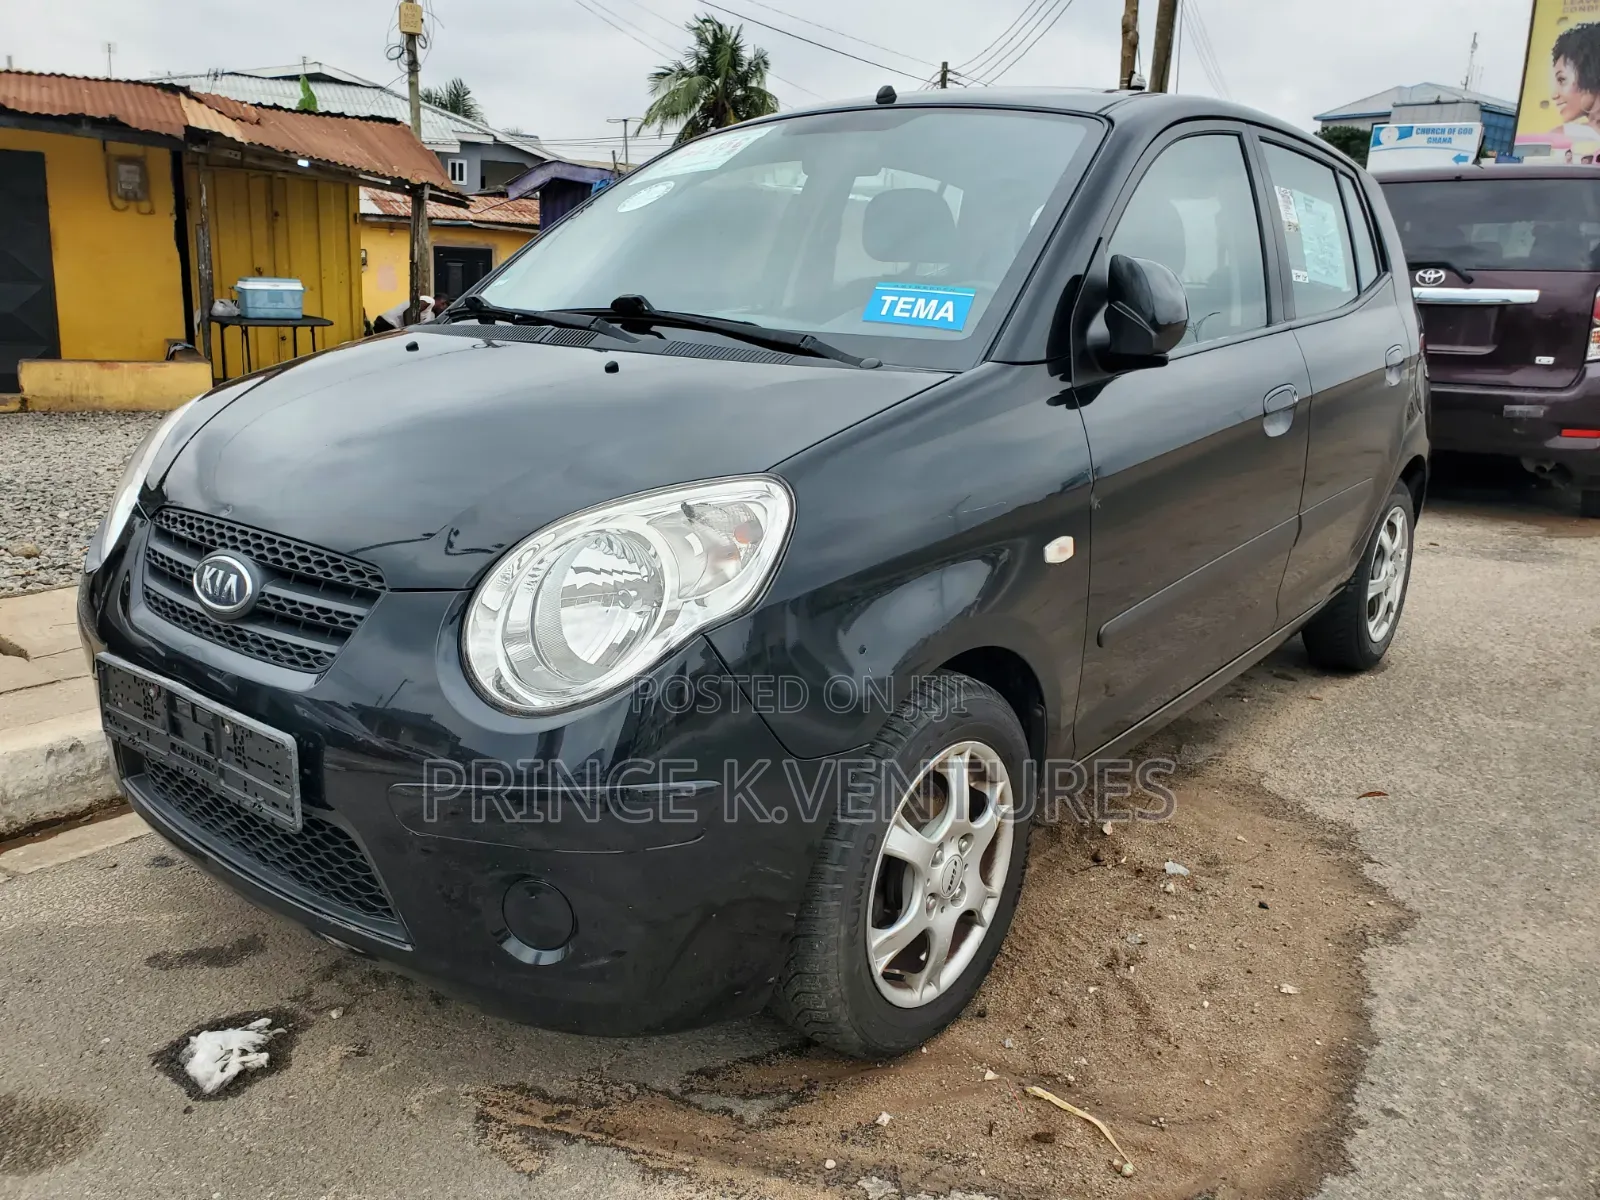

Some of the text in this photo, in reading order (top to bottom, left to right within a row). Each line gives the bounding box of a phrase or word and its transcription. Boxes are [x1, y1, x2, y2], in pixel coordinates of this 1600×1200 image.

[1415, 127, 1474, 135] CHURCH OF GOD
[1426, 136, 1453, 145] GHANA
[880, 295, 955, 323] TEMA
[201, 565, 238, 603] KIA
